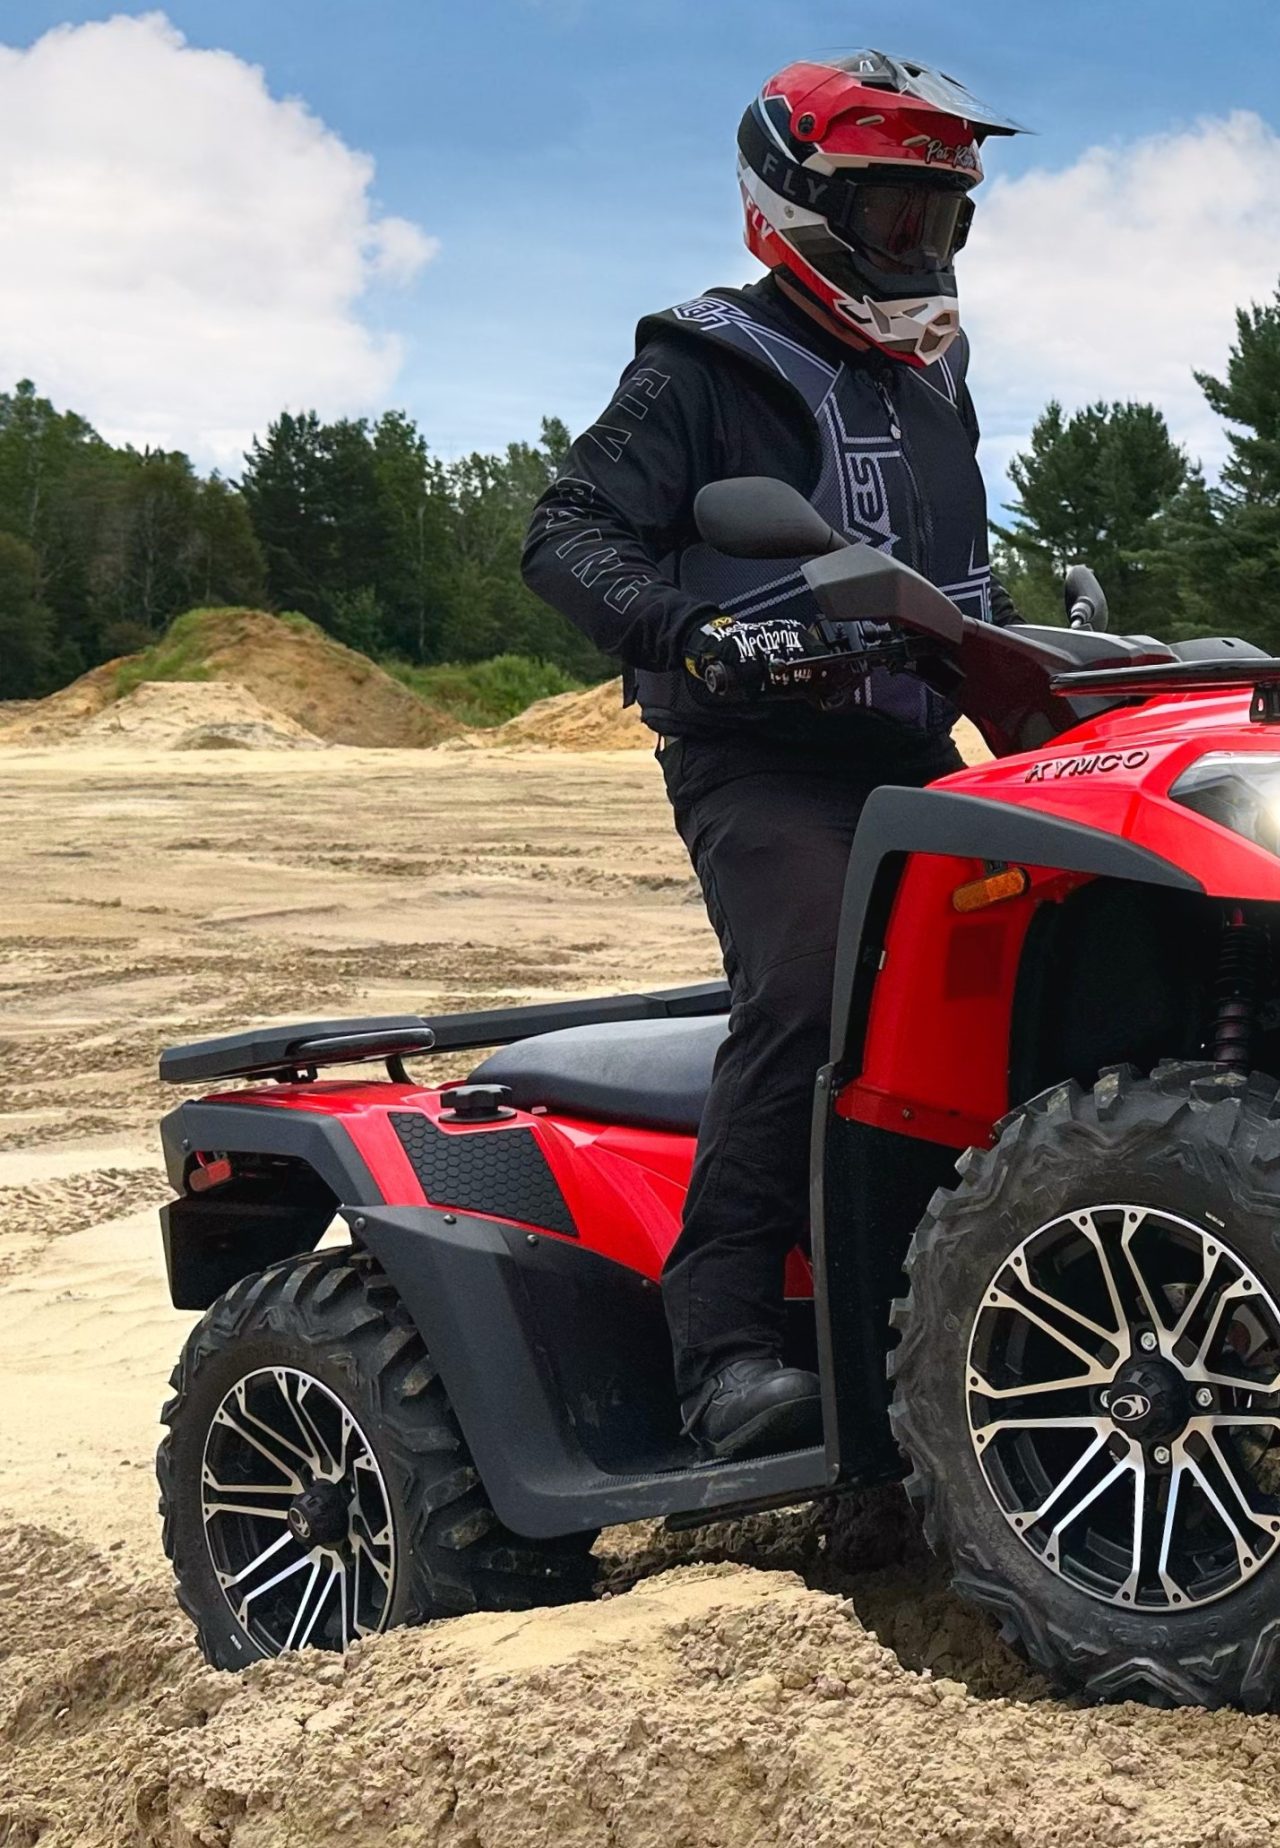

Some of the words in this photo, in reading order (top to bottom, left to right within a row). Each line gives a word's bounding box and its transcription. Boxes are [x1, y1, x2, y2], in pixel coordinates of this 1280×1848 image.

[761, 152, 829, 205] FLY
[732, 625, 804, 662] Mechanix
[1024, 749, 1150, 783] KYMCO
